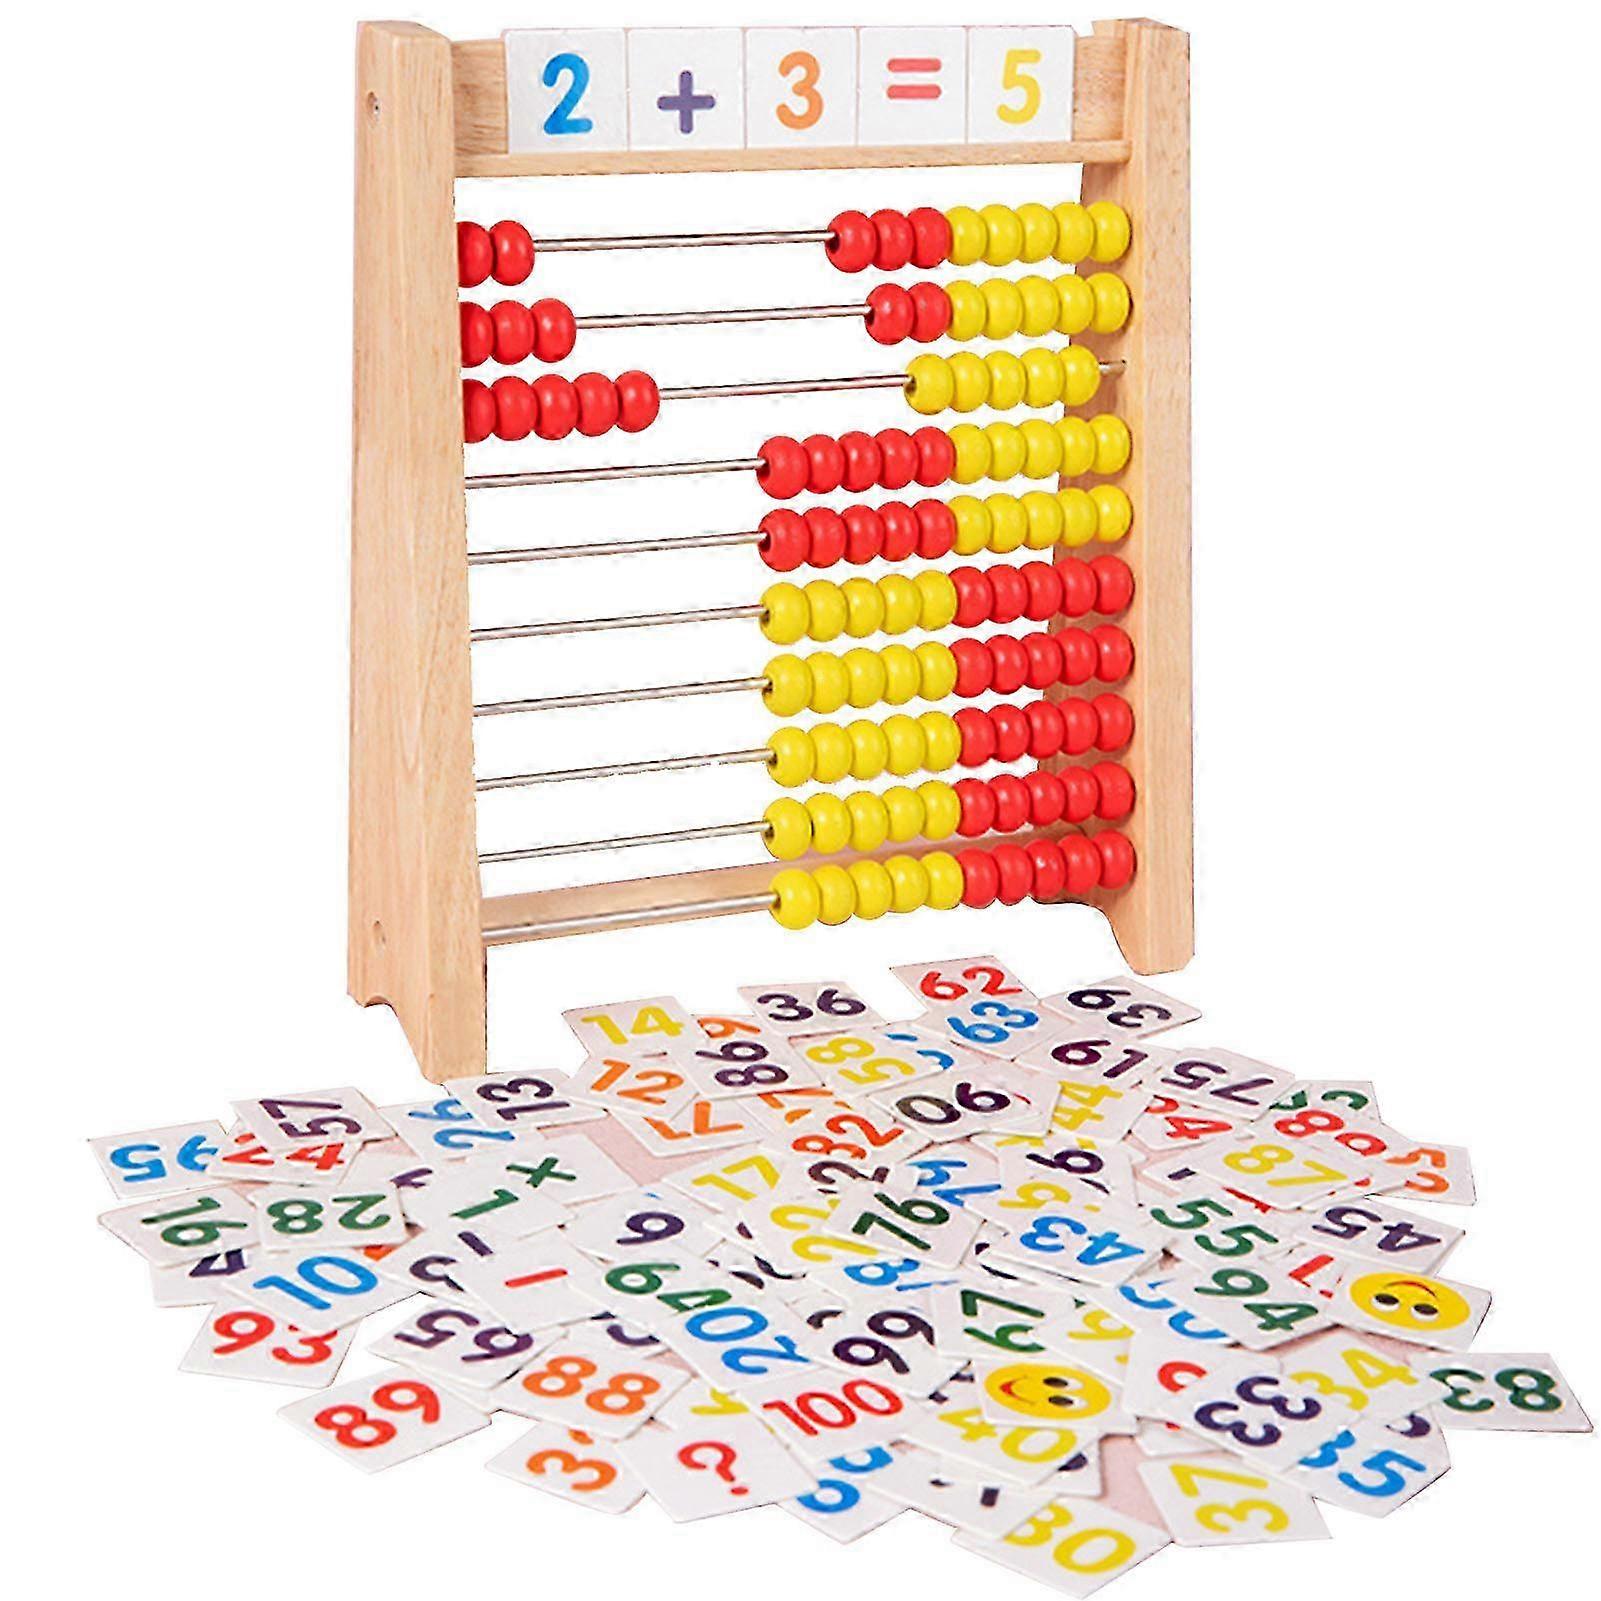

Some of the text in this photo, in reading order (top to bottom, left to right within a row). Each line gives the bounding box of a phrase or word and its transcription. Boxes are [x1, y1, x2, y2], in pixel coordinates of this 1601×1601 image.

[543, 53, 593, 134] 2
[776, 51, 823, 130] 3
[996, 49, 1041, 125] 5
[756, 987, 867, 1022] 36
[919, 965, 1023, 1001] 62
[581, 1005, 685, 1046] 14
[590, 1059, 685, 1105] 12
[1050, 1079, 1124, 1132] 44
[691, 1154, 782, 1202] 17
[1222, 1143, 1348, 1188] 87
[266, 1193, 392, 1235] 28
[851, 1191, 950, 1251] 76
[1019, 1215, 1145, 1266] 43
[1149, 1198, 1279, 1257] 55
[1311, 1206, 1442, 1253] 45
[252, 1255, 379, 1311] 10
[684, 1306, 812, 1376] 20
[521, 1355, 662, 1416] 88
[1290, 1348, 1419, 1411] 34
[1428, 1367, 1563, 1413] 83
[762, 1378, 904, 1436] 100
[1193, 1375, 1322, 1447] 33
[937, 1407, 1078, 1464] 40
[1169, 1463, 1290, 1535] 37
